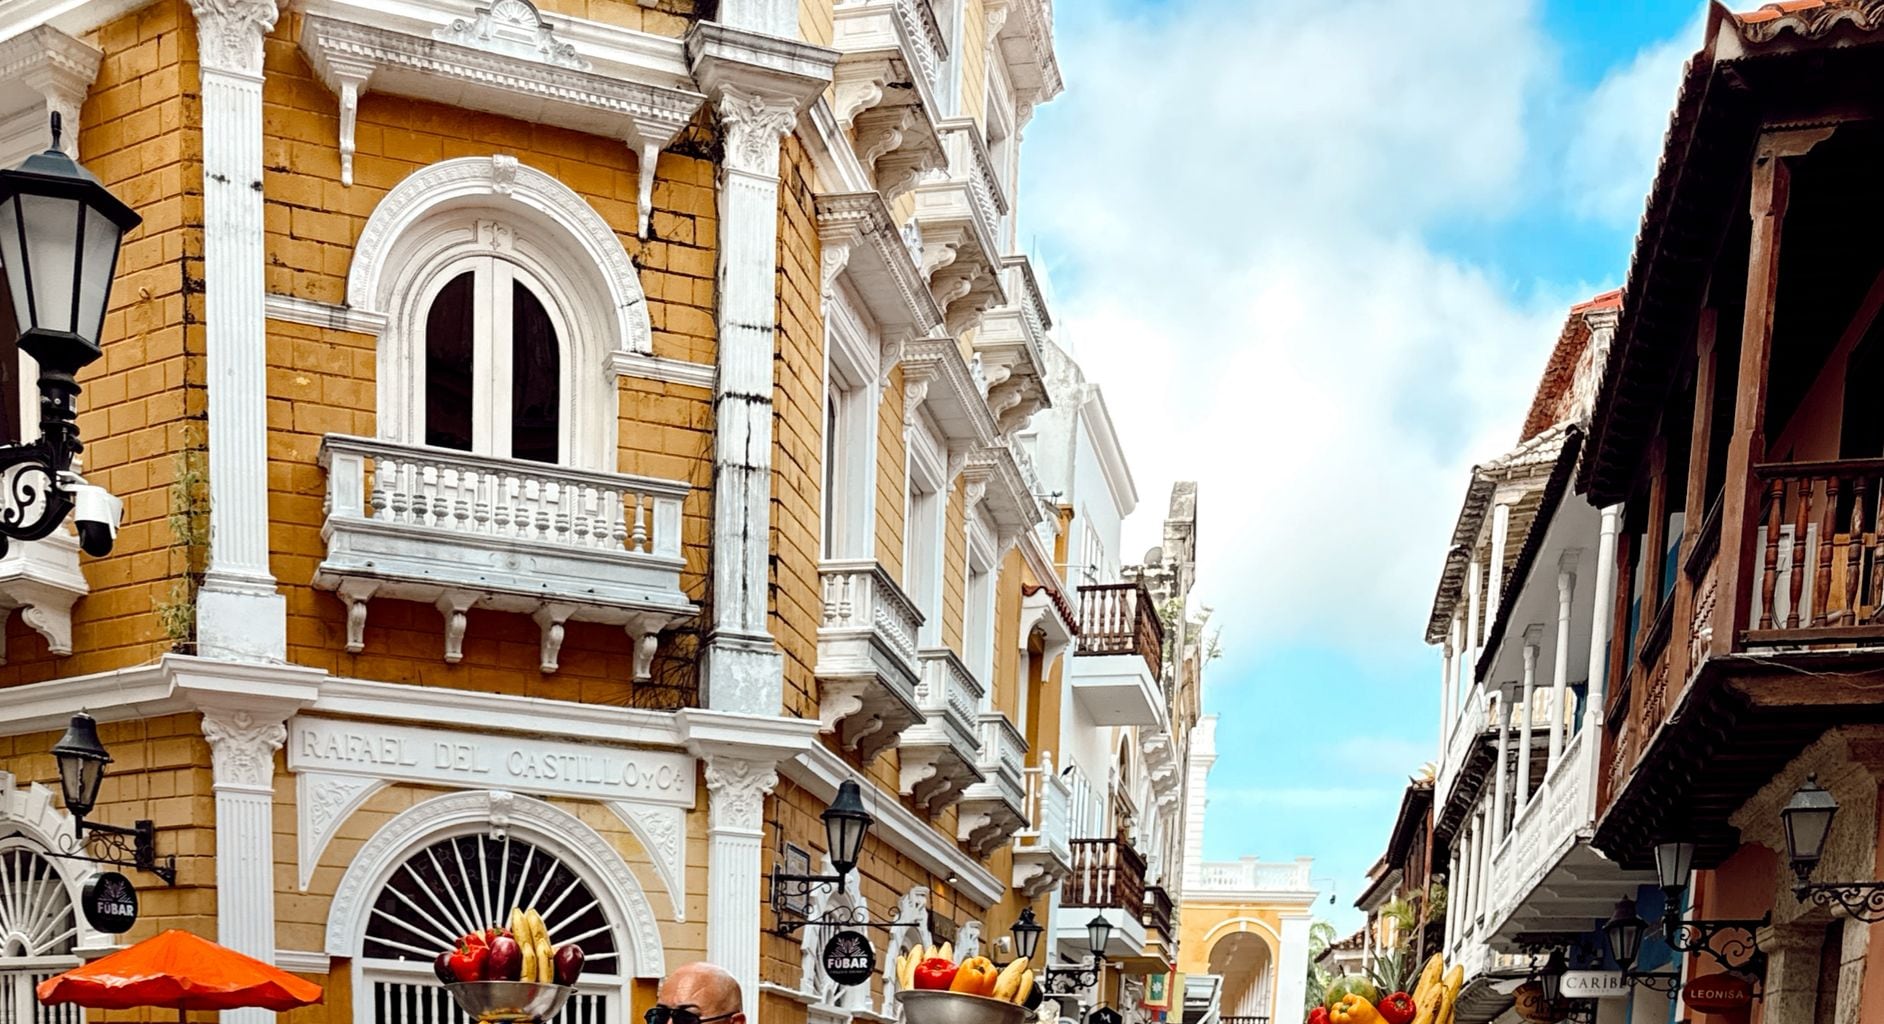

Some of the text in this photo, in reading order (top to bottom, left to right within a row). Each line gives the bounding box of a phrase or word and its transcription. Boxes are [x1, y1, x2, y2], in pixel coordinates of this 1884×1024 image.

[301, 728, 418, 768] RAFAEL
[434, 741, 490, 774] DEL
[505, 750, 640, 788] CASTILLO
[1690, 989, 1744, 999] LEONISA
